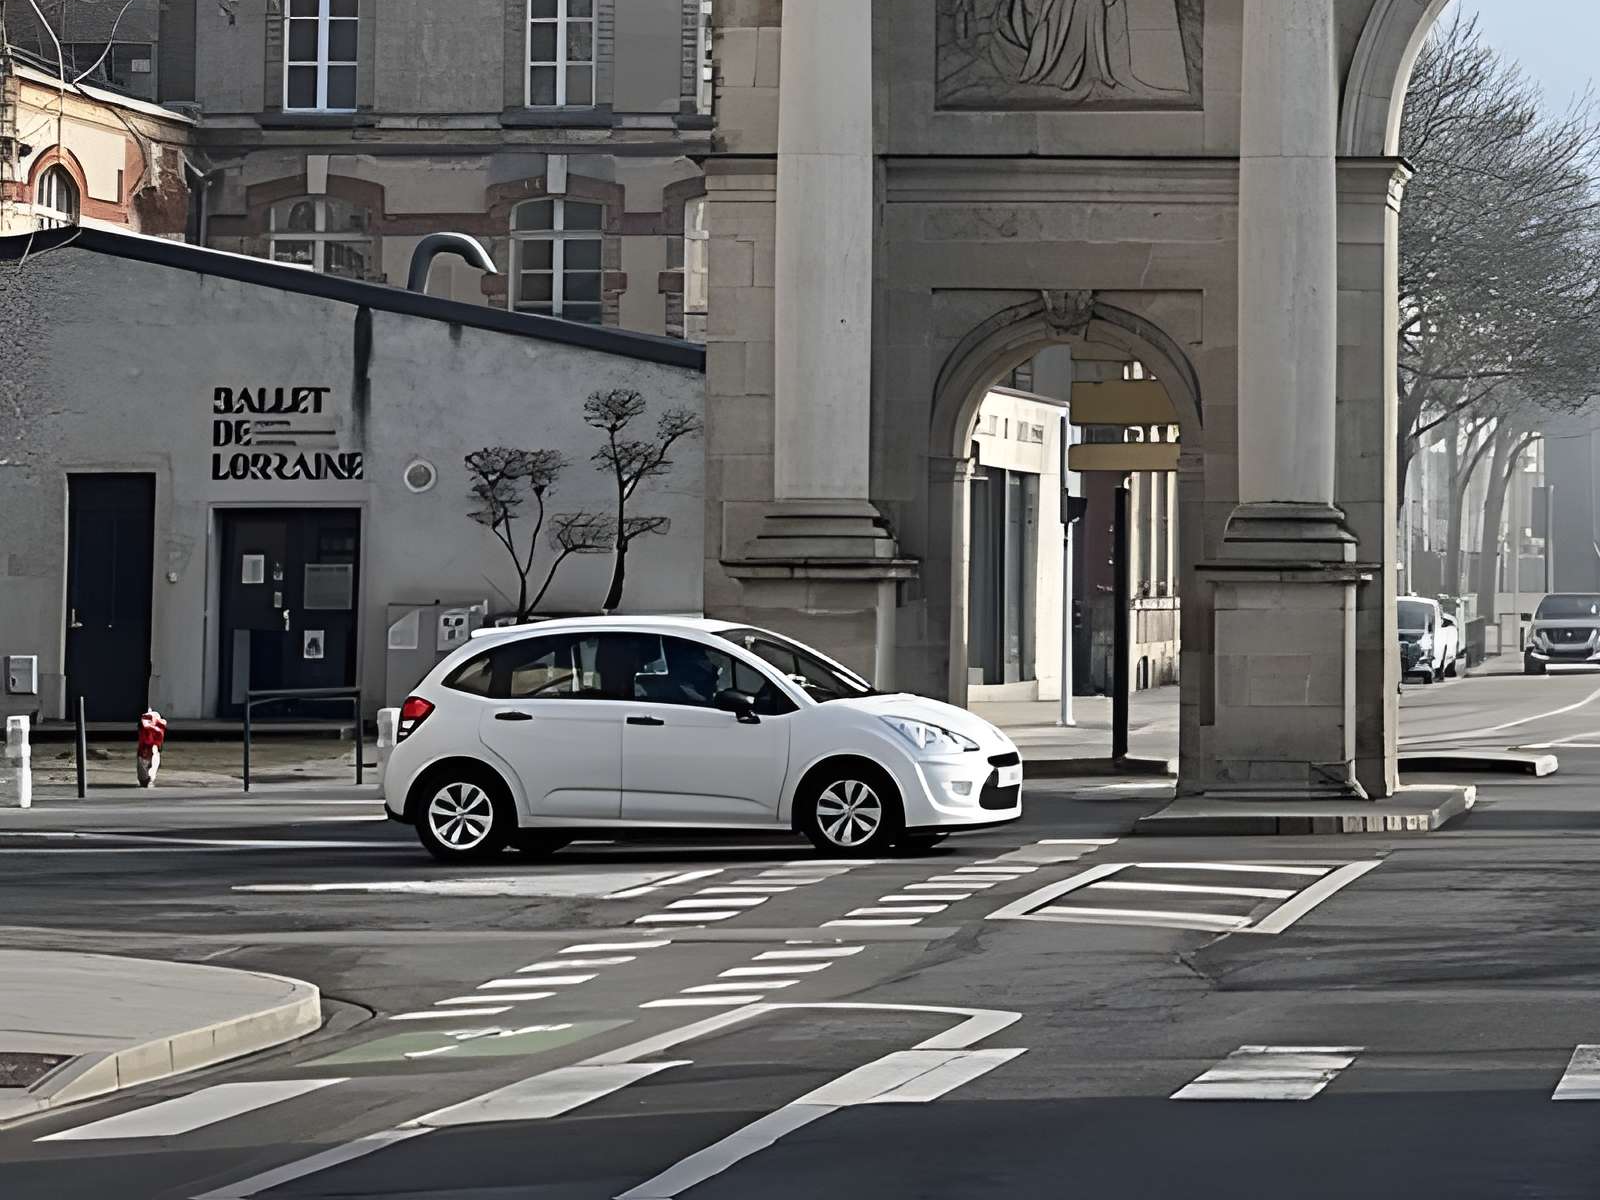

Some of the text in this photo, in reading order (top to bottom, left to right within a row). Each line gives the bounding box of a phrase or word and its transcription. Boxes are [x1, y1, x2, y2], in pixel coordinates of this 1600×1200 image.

[213, 387, 331, 414] BALLET
[212, 419, 251, 447] DE
[212, 452, 364, 481] LORRAINE
